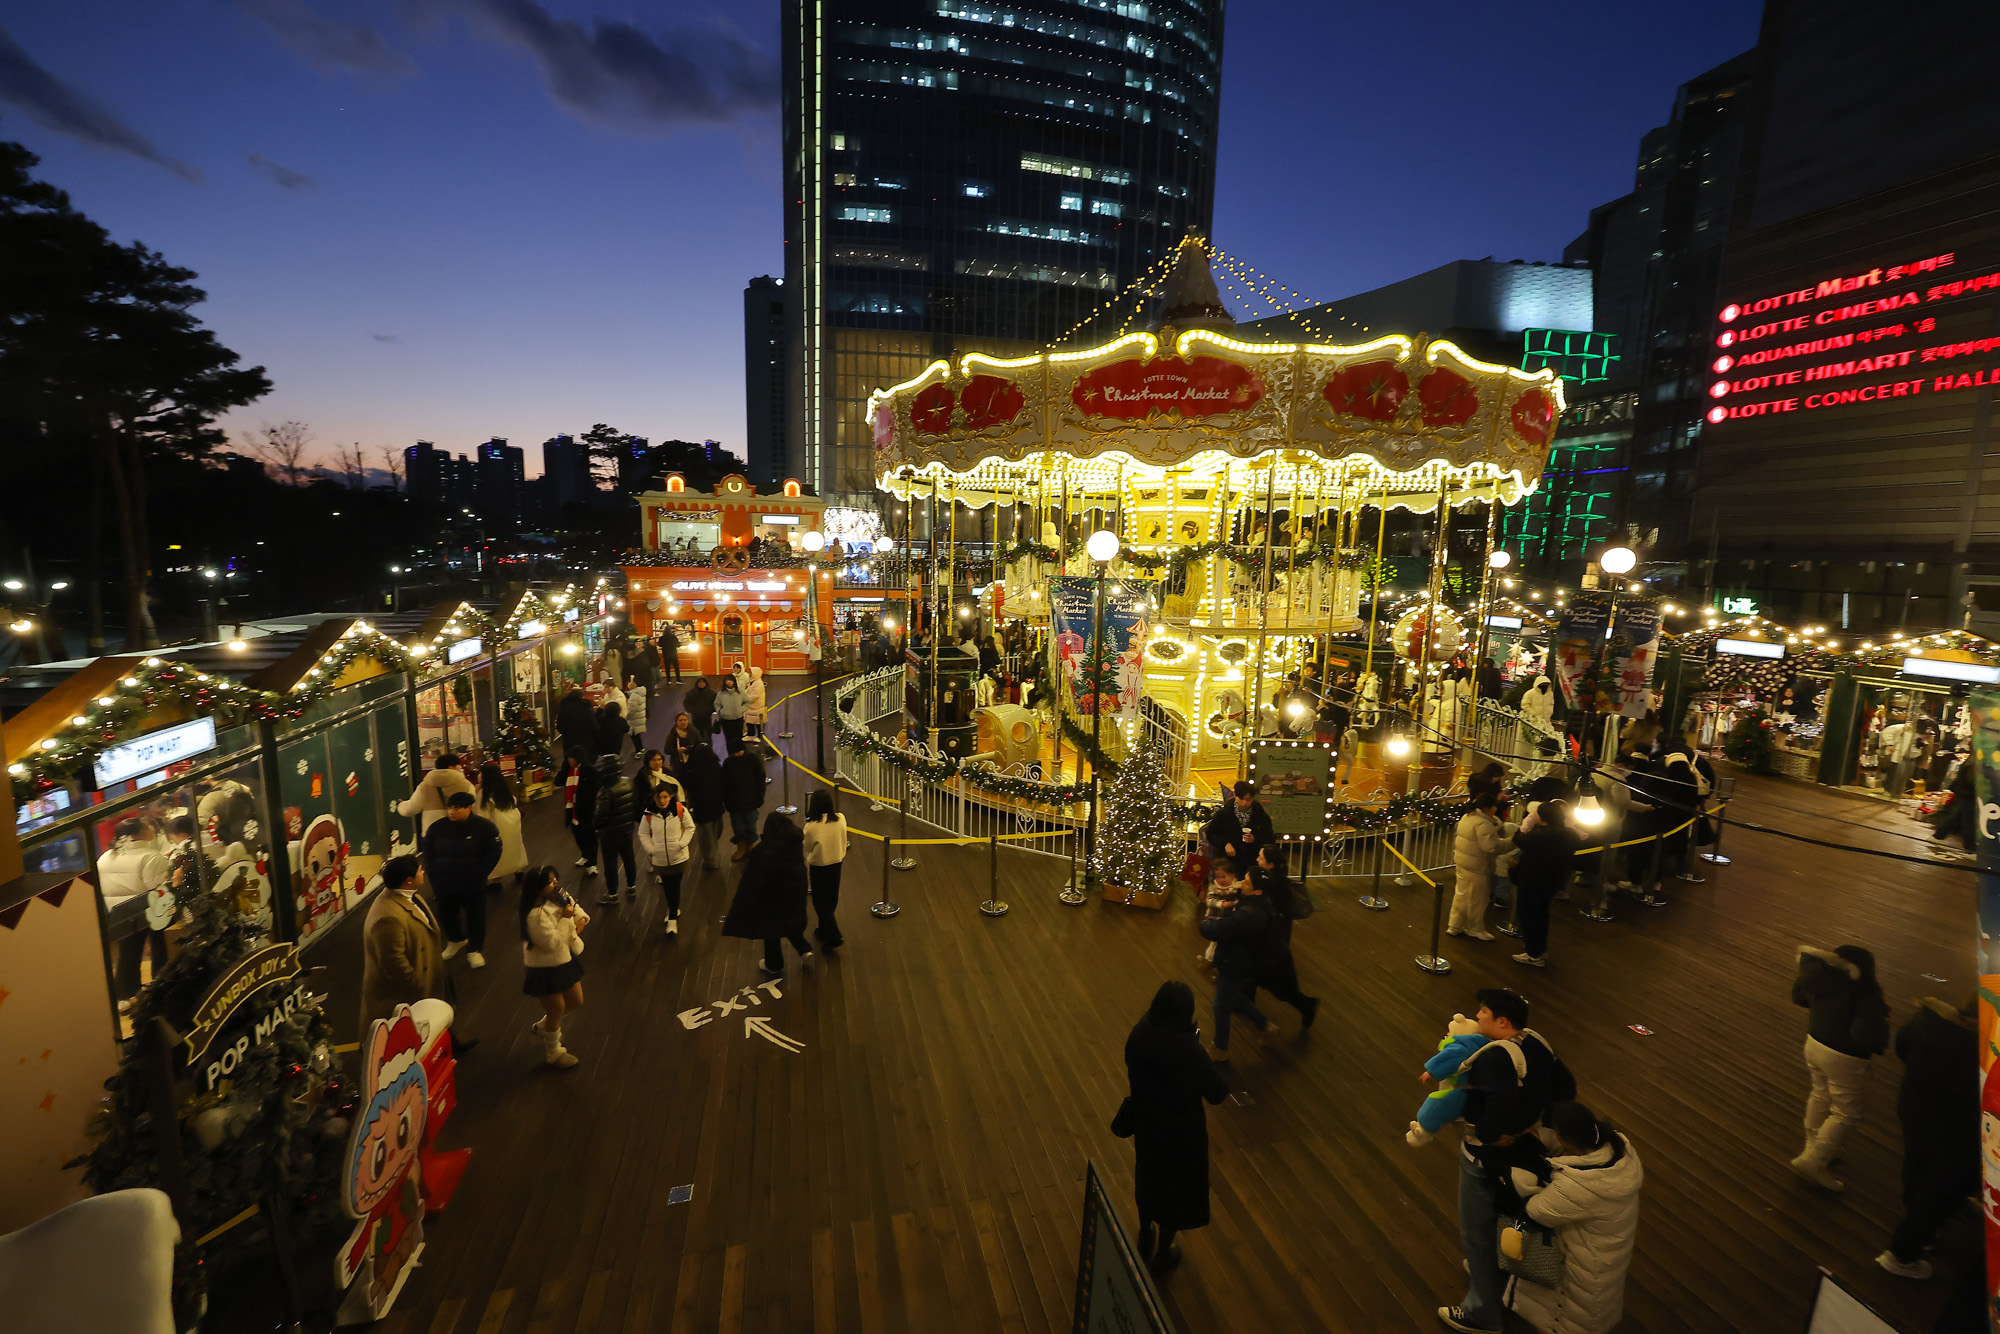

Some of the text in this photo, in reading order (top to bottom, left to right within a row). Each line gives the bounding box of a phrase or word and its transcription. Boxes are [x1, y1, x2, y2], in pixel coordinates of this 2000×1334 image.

[1739, 315, 1811, 342] LOTTE
[1814, 292, 1920, 325] CINEMA
[1742, 287, 1814, 316] LOTTE
[1736, 332, 1854, 367] AQUARIUM
[1143, 374, 1189, 384] LOTTE TOWN
[1731, 370, 1802, 393] LOTTE
[1804, 350, 1917, 382] HIMART
[1102, 385, 1230, 402] Christmas Market
[1729, 397, 1799, 419] LOTTE
[1804, 379, 1926, 409] CONCERT
[1052, 598, 1095, 608] Christmas
[210, 956, 280, 1020] UNBOX JOY
[207, 985, 305, 1091] POP MART
